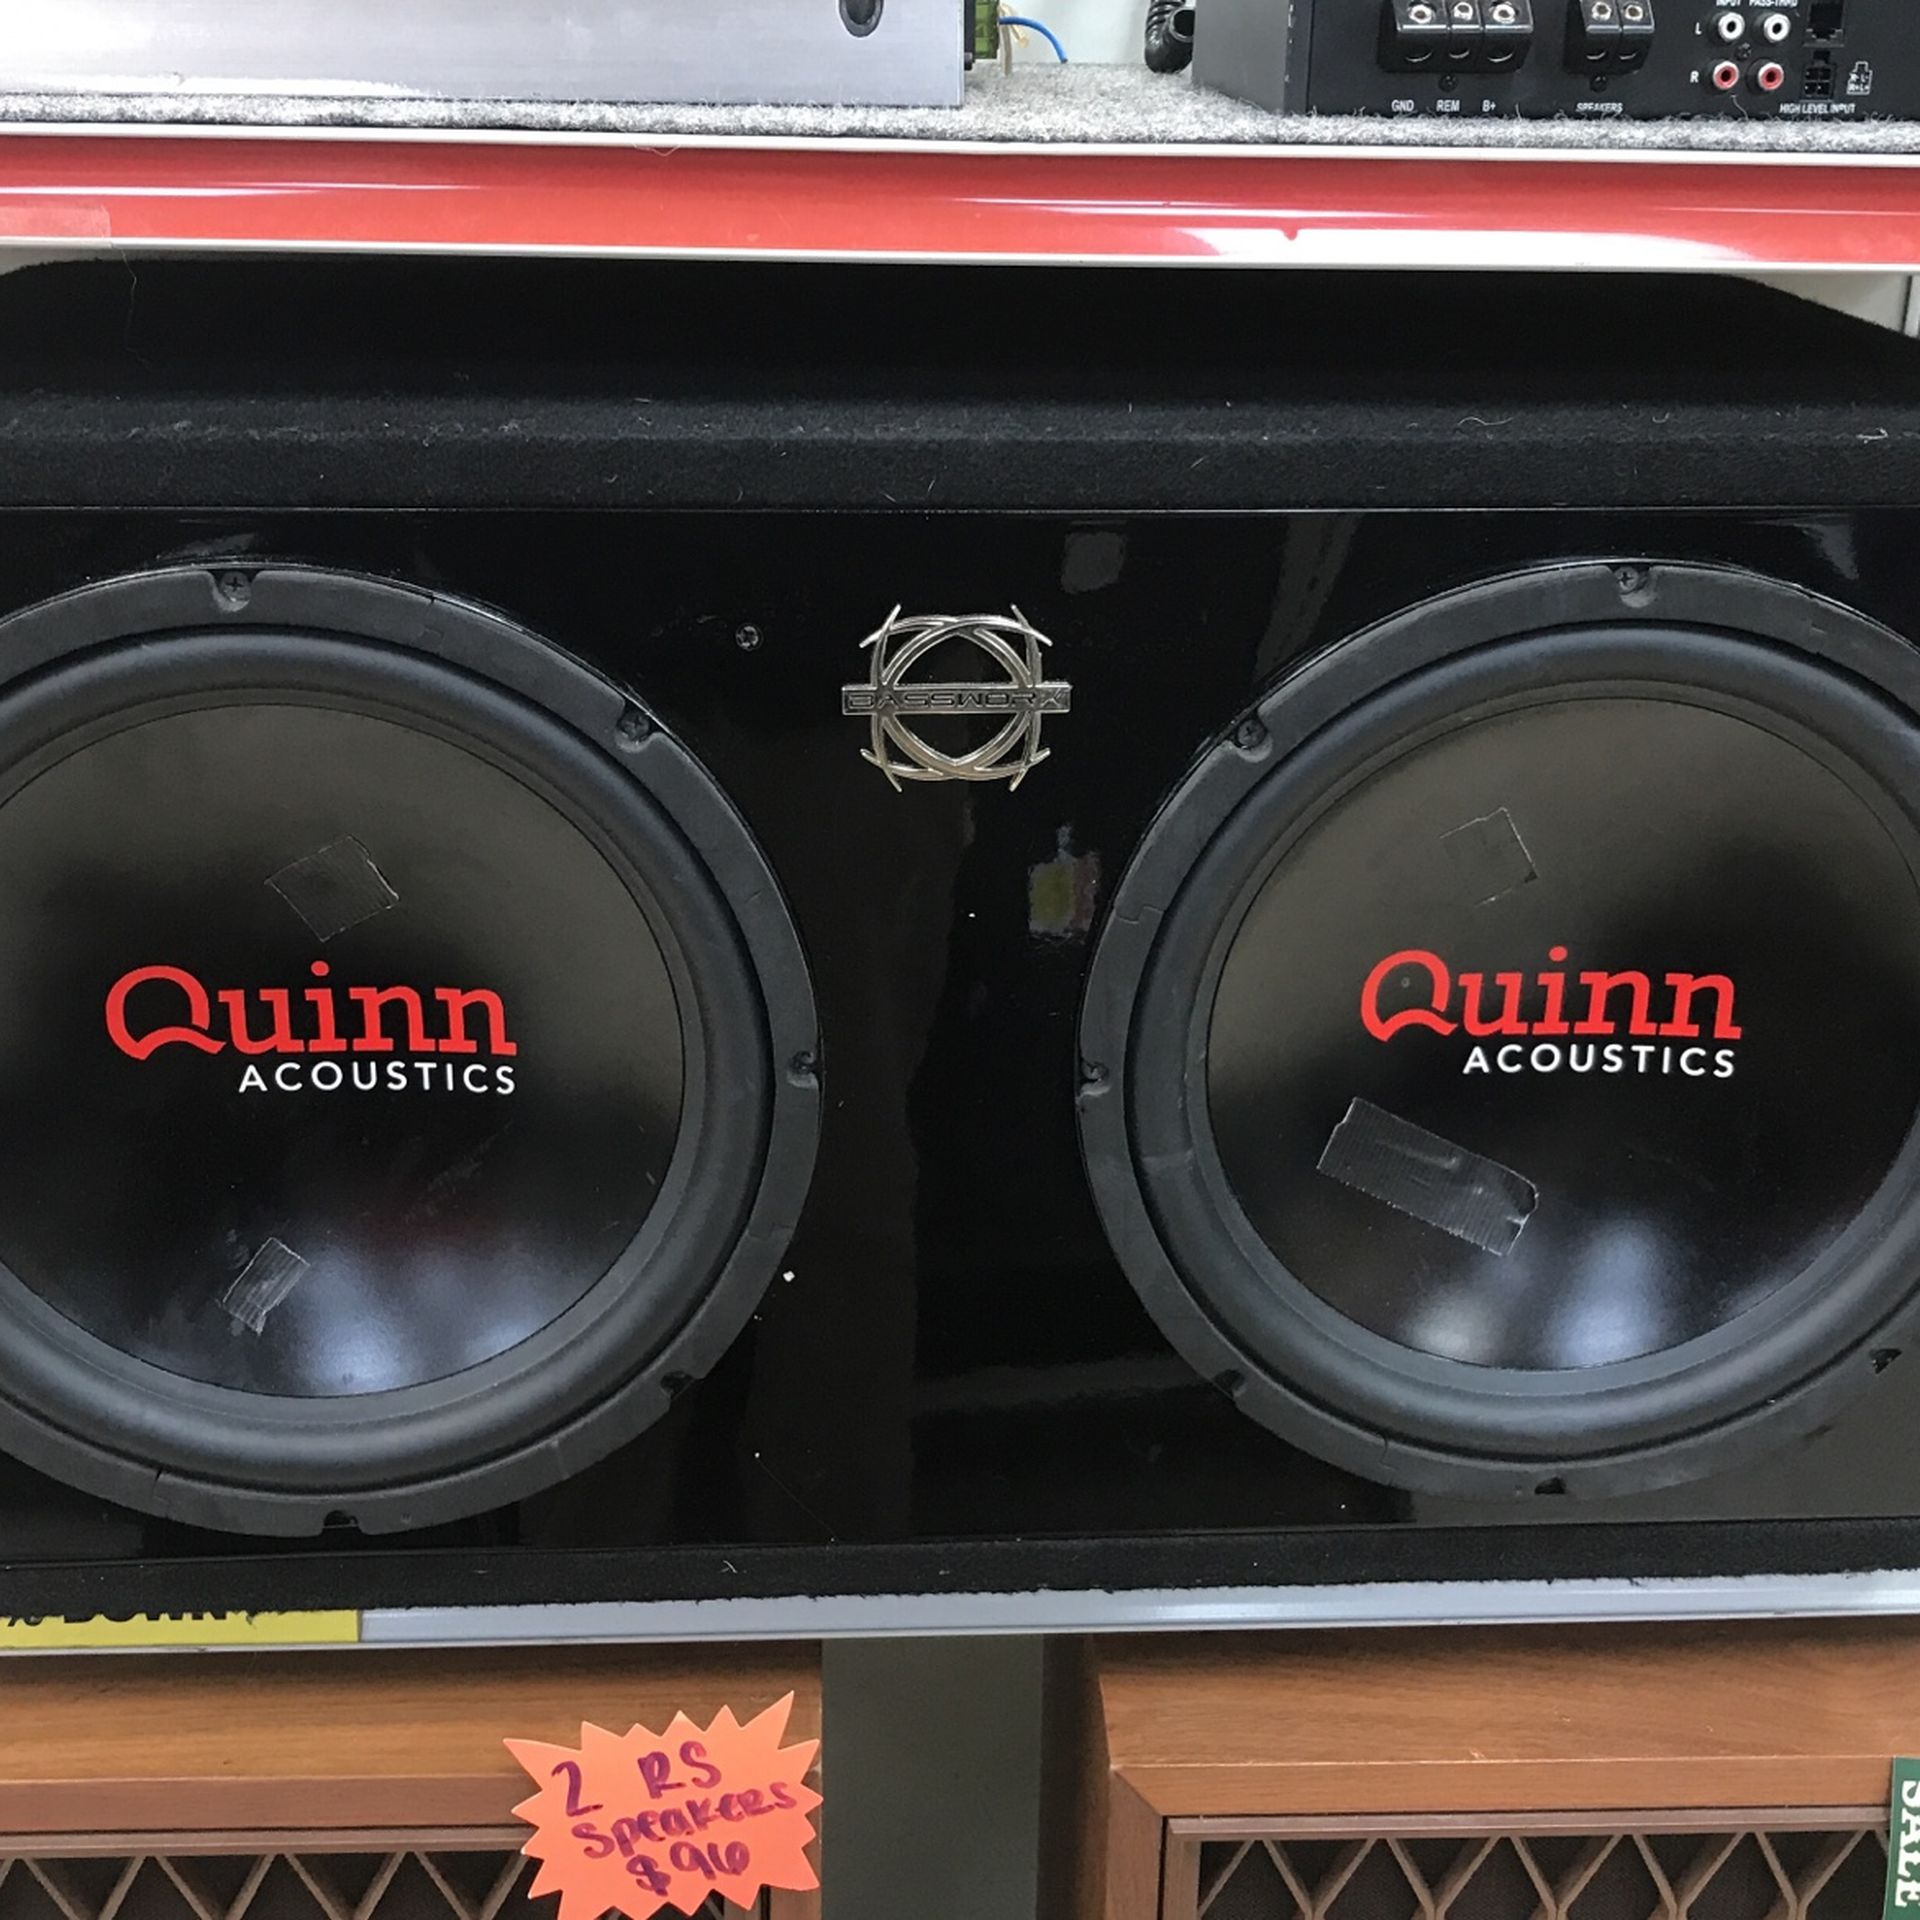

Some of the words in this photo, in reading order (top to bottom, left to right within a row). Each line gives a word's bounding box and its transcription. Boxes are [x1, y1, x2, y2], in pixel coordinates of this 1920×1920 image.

[1695, 22, 1702, 35] L
[1690, 70, 1699, 83] R
[1391, 99, 1415, 112] GND
[1436, 99, 1460, 112] REM
[1482, 99, 1496, 112] B+
[1576, 101, 1623, 113] SPEAKERS
[1779, 102, 1801, 114] HIGH
[1802, 102, 1828, 114] LEVEL
[1830, 102, 1856, 114] INPUT
[1360, 945, 1742, 1043] Quinn
[105, 960, 518, 1061] Quinn
[1462, 1043, 1736, 1078] ACOUSTICS
[238, 1061, 517, 1095] ACOUSTICS
[551, 1761, 604, 1818] 2
[637, 1740, 722, 1800] RS
